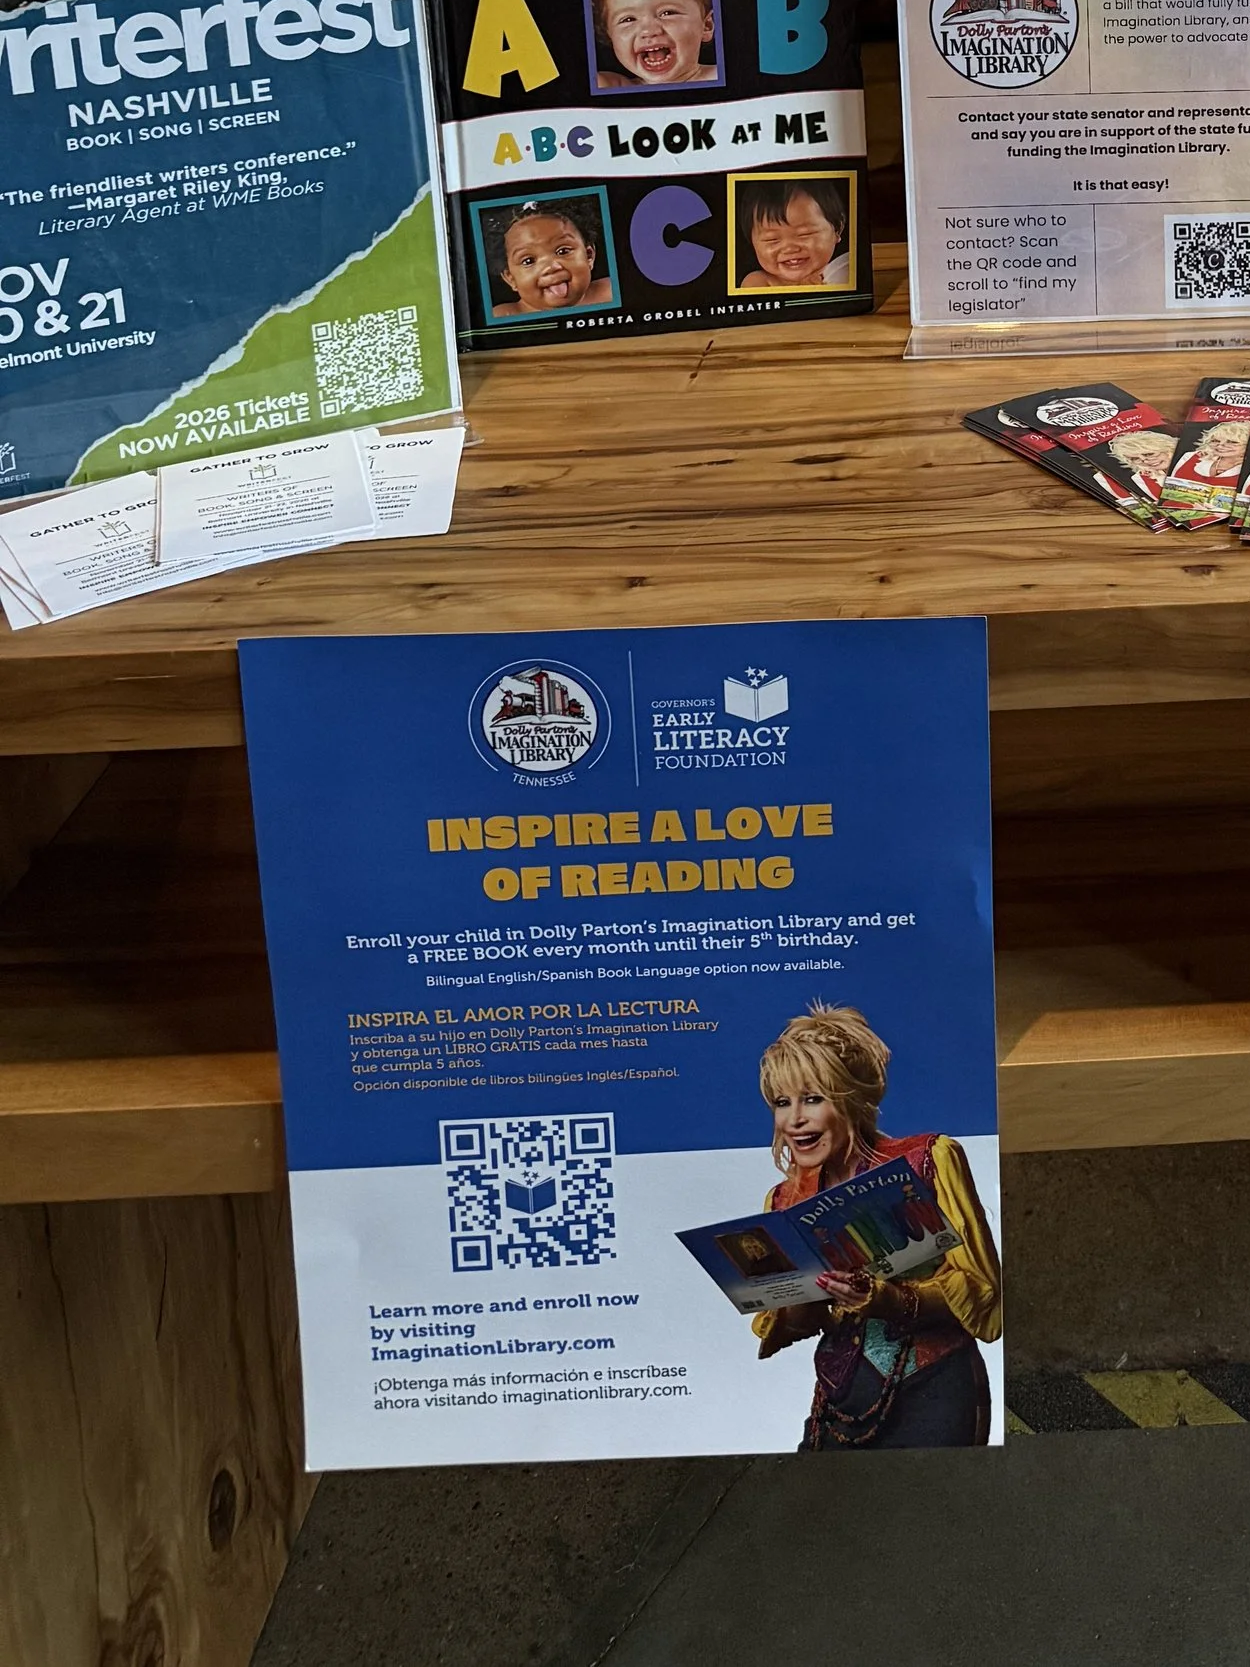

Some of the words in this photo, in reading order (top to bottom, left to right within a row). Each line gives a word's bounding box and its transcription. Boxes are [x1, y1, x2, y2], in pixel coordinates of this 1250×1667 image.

[1102, 1, 1111, 10] a
[1103, 15, 1180, 30] Imagination
[1184, 14, 1229, 28] Library,
[941, 31, 1069, 56] IMAGINATION
[1103, 33, 1125, 44] the
[1127, 34, 1168, 47] power
[1170, 33, 1184, 43] to
[1186, 31, 1248, 42] advocate
[965, 55, 1048, 77] LIBRARY
[68, 77, 272, 127] NASHVILLE
[66, 131, 123, 151] BOOK
[138, 122, 192, 140] SONG
[208, 109, 280, 131] SCREEN
[607, 116, 716, 157] LOOK
[731, 124, 762, 145] AT
[774, 112, 826, 145] ME
[49, 171, 153, 199] friendliest
[158, 163, 228, 184] writers
[182, 178, 231, 196] Riley
[237, 171, 287, 188] King,
[38, 213, 115, 235] Literary
[120, 201, 181, 223] Agent
[186, 197, 206, 212] at
[212, 187, 262, 208] WME
[267, 179, 324, 200] Books
[630, 185, 714, 286] C
[34, 300, 71, 337] &
[78, 288, 126, 330] 21
[566, 314, 633, 328] ROBERTA
[643, 308, 701, 321] GROBEL
[710, 301, 782, 315] INTRATER
[66, 330, 156, 356] University
[174, 404, 231, 429] 2026
[233, 391, 309, 417] Tickets
[118, 431, 178, 458] NOW
[185, 406, 311, 446] AVAILABLE
[652, 712, 715, 727] EARLY
[491, 730, 592, 750] IMAGINATION
[653, 726, 790, 751] LITERACY
[510, 747, 575, 765] LIBRARY
[655, 752, 786, 770] FOUNDATION
[513, 771, 576, 787] TENNESSEE
[427, 811, 640, 852] INSPIRE
[650, 810, 686, 842] A
[695, 803, 833, 841] LOVE
[482, 866, 551, 901] OF
[561, 856, 795, 897] READING
[347, 1010, 429, 1028] INSPIRA
[434, 1009, 459, 1024] EL
[463, 1005, 525, 1022] AMOR
[529, 1003, 572, 1019] POR
[576, 1002, 602, 1017] LA
[607, 998, 700, 1016] LECTURA
[373, 1396, 420, 1410] ahora
[424, 1391, 498, 1407] visitando
[502, 1385, 692, 1405] imaginationlibrary.com.
